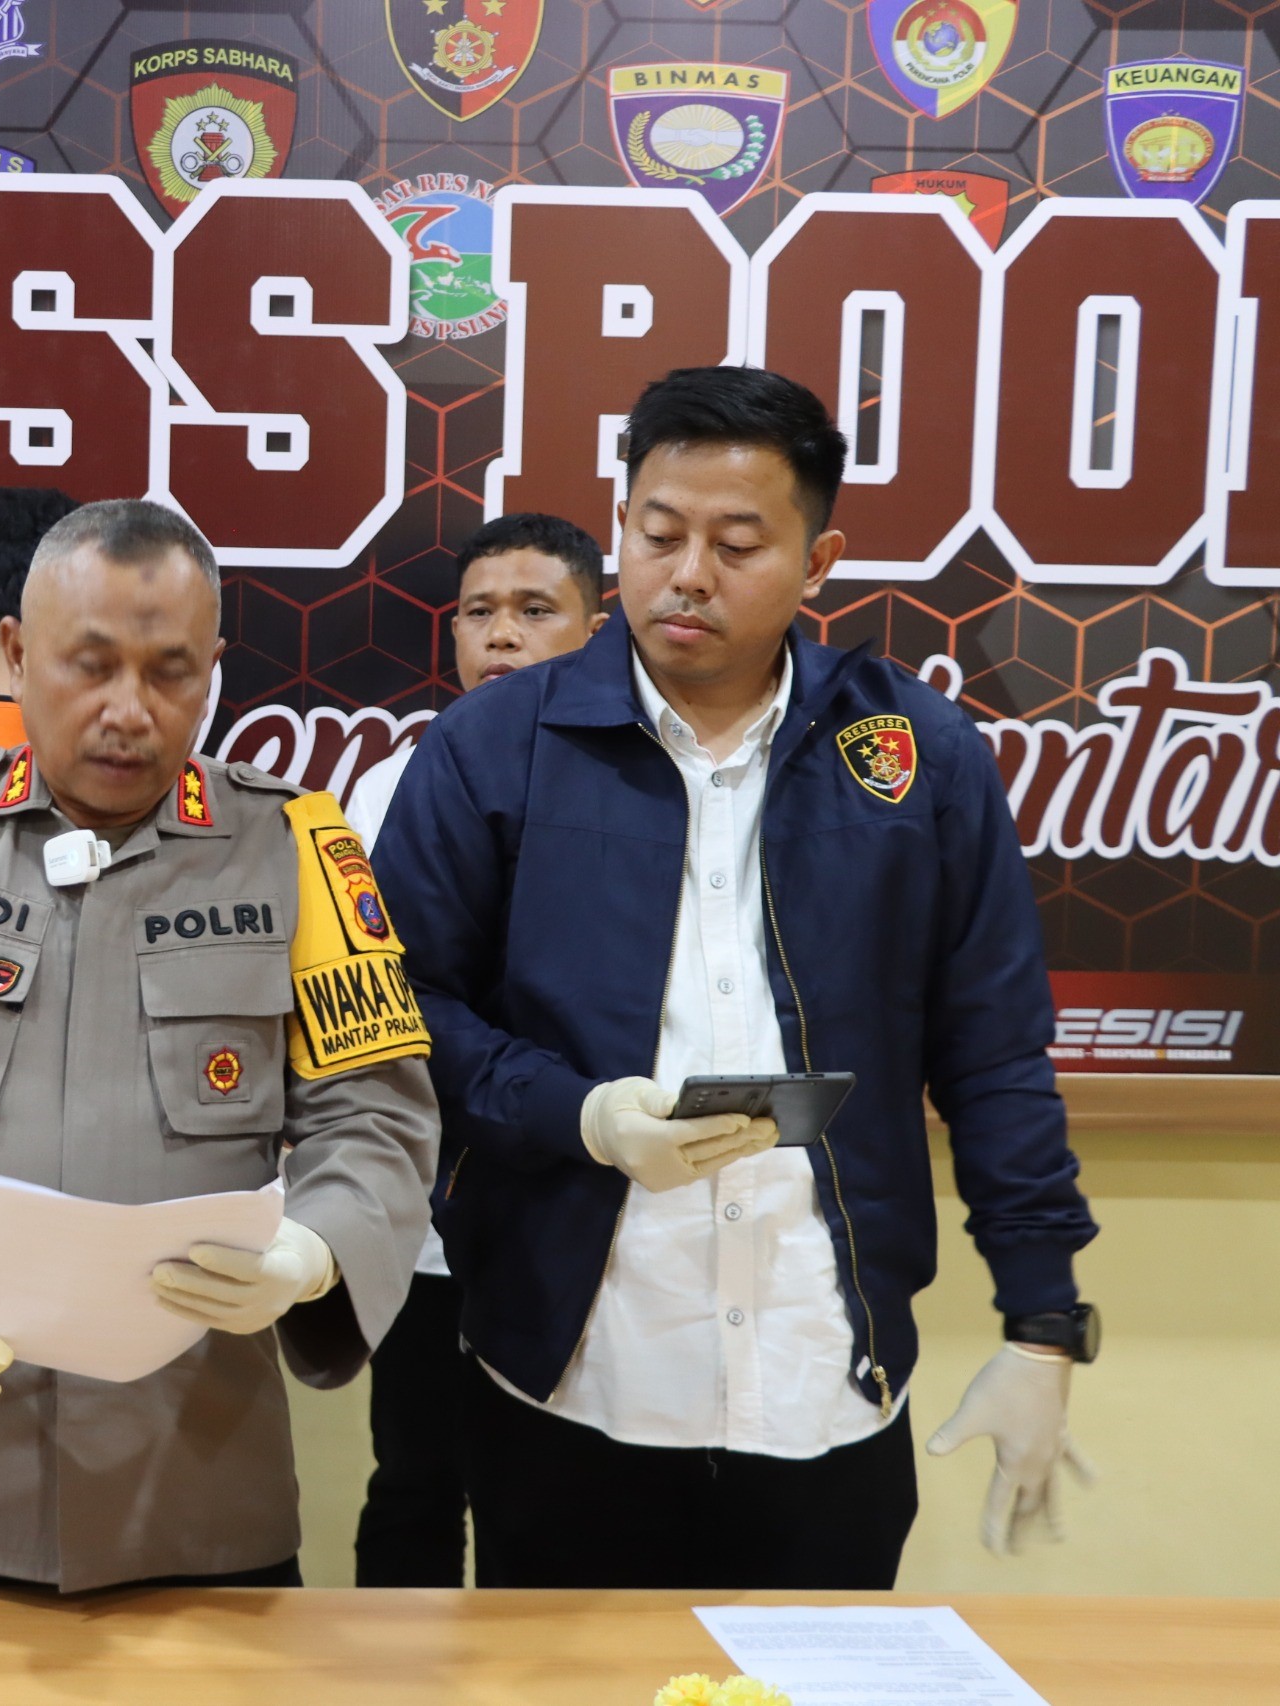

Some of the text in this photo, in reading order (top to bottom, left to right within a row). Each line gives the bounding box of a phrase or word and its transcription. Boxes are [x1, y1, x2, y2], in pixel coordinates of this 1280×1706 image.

[133, 48, 294, 83] KORPS SABHARA
[634, 70, 760, 89] BINMAS
[1115, 67, 1238, 90] KEUANGAN
[916, 179, 967, 189] HUKUM
[843, 718, 904, 741] RESERSE
[144, 903, 274, 944] POLRI
[301, 959, 394, 1035] WAKA
[321, 1022, 381, 1056] MANTAP
[1054, 1008, 1244, 1046] ESISI
